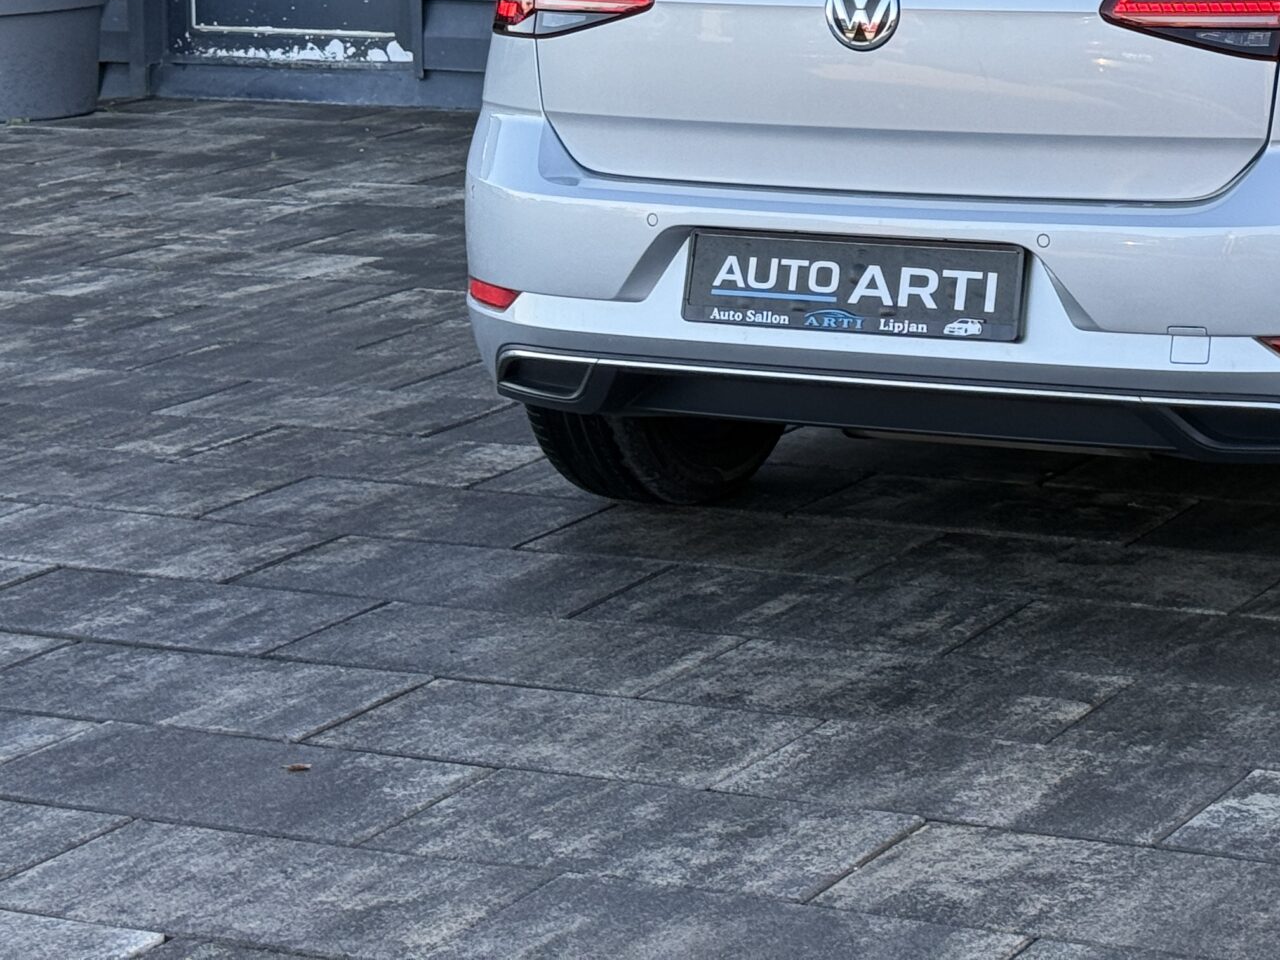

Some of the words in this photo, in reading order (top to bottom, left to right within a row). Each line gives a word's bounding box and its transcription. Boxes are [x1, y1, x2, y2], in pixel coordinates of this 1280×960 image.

[711, 255, 841, 294] AUTO
[847, 265, 998, 313] ARTI
[710, 307, 742, 321] Auto
[746, 310, 790, 325] Sallon
[804, 315, 864, 330] ARTI
[879, 318, 928, 334] Lipjan
